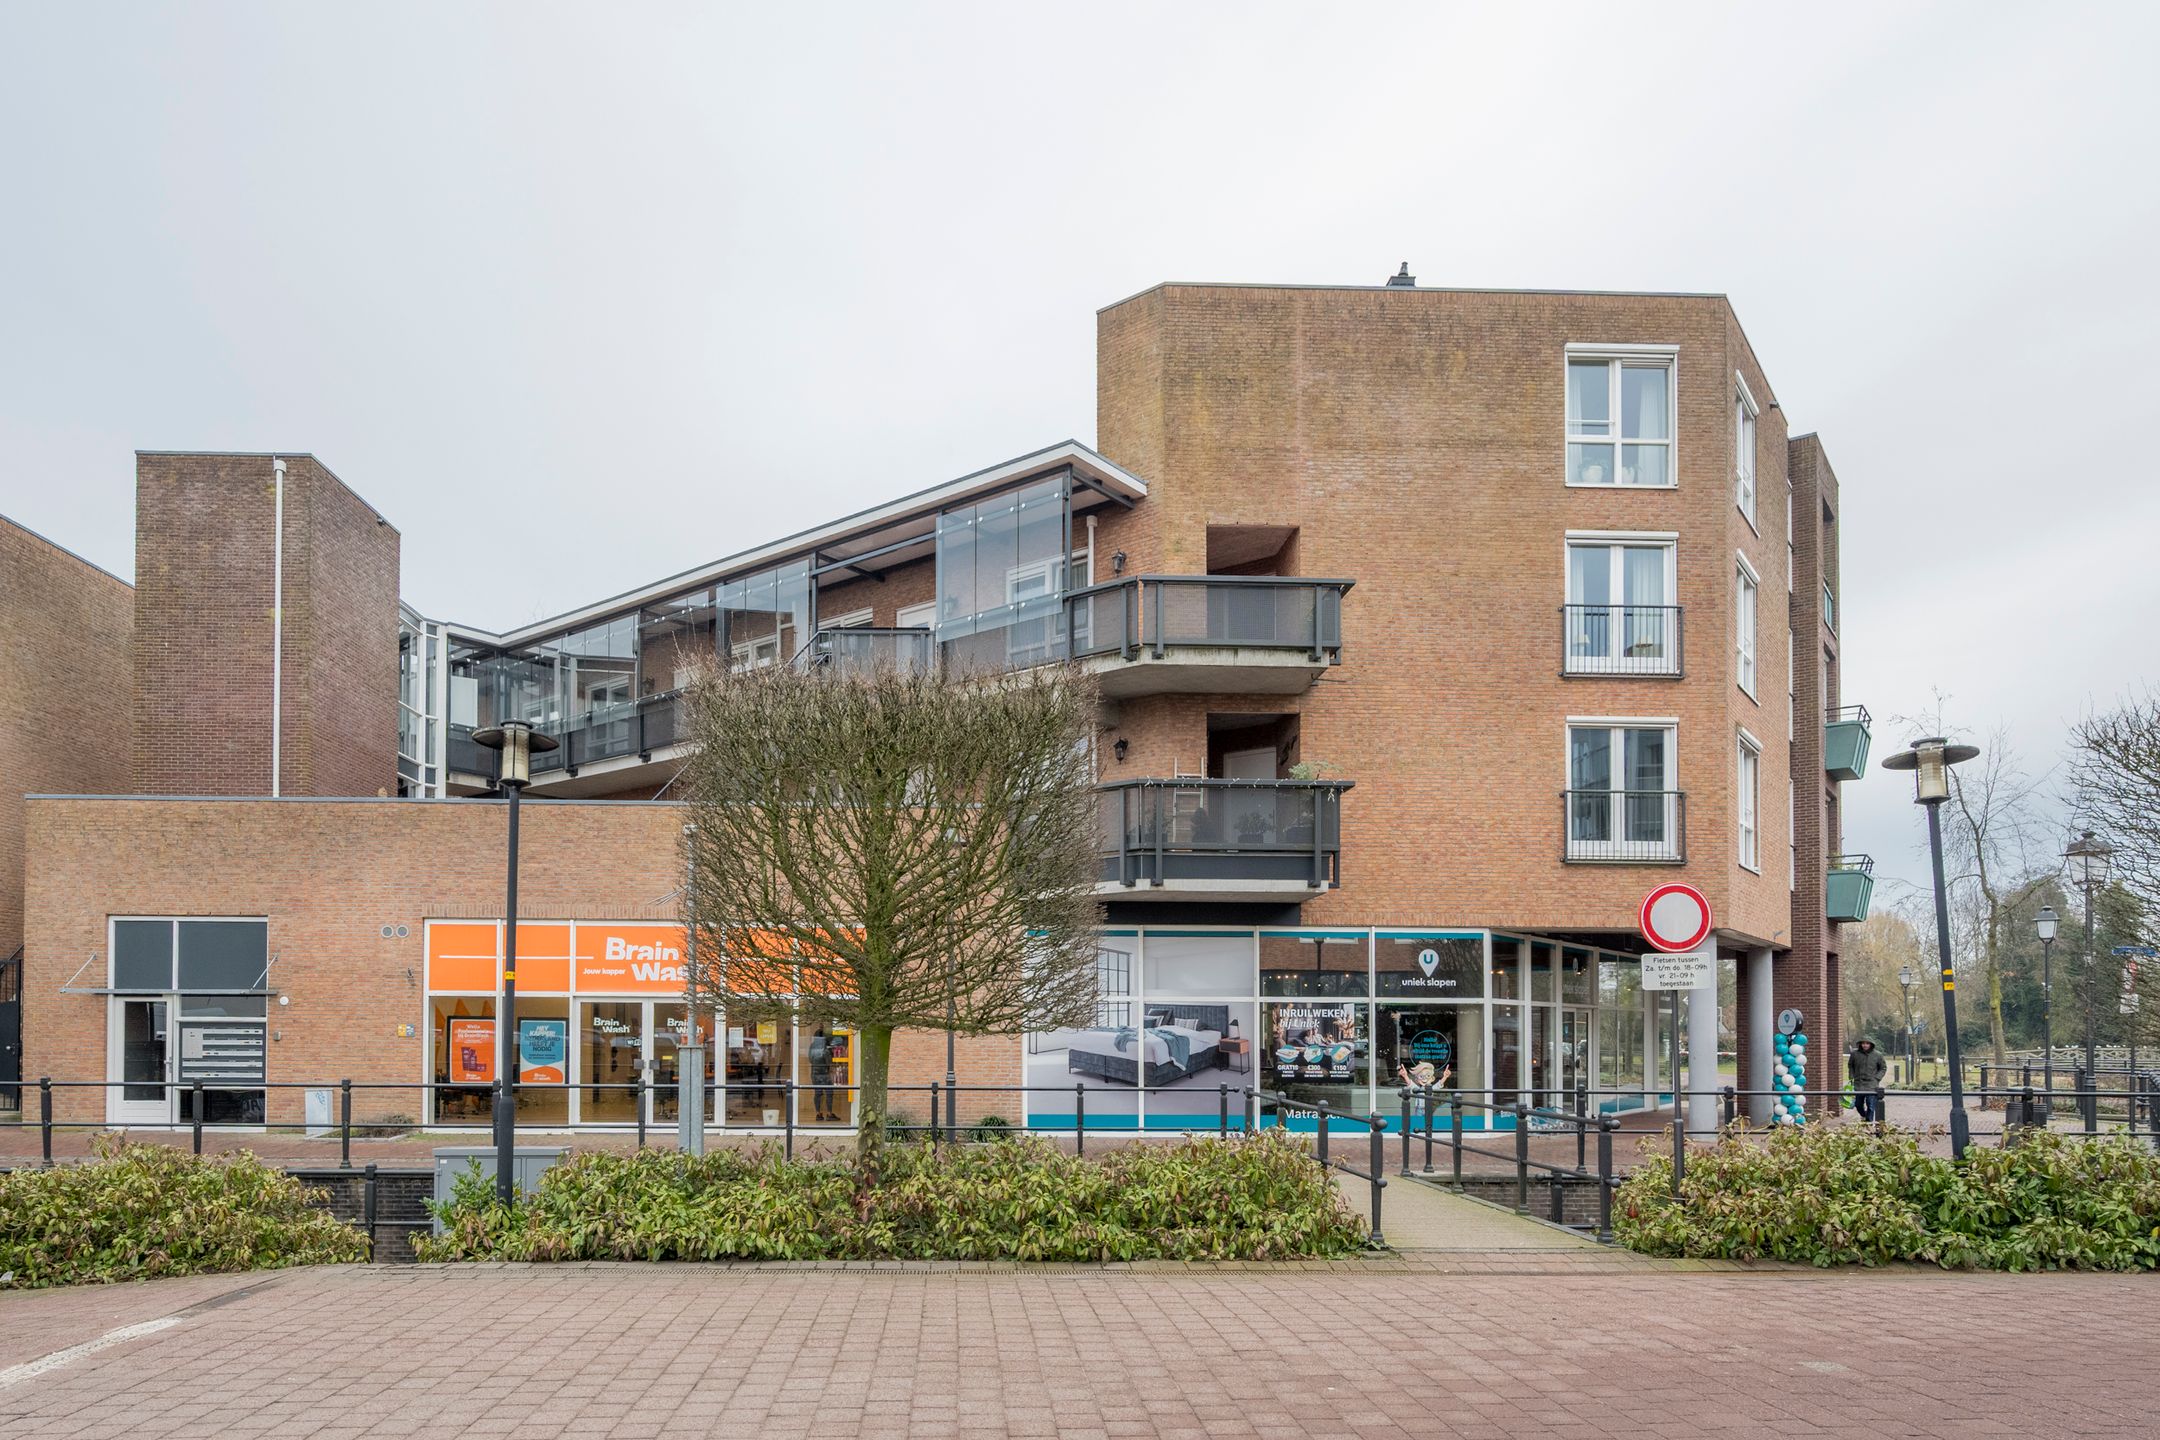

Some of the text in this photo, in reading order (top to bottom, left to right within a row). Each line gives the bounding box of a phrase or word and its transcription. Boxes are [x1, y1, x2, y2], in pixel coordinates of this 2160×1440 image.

[605, 936, 679, 961] Brain
[1424, 954, 1433, 964] U
[583, 967, 626, 976] Jouw kapper
[1402, 978, 1457, 988] uniek slapen
[1279, 1008, 1348, 1018] INRUILWEKEN
[593, 1017, 620, 1026] Brain
[1280, 1019, 1292, 1029] bij
[602, 1025, 630, 1033] Wash
[676, 1025, 703, 1034] Wh
[1285, 1109, 1345, 1119] Matra
